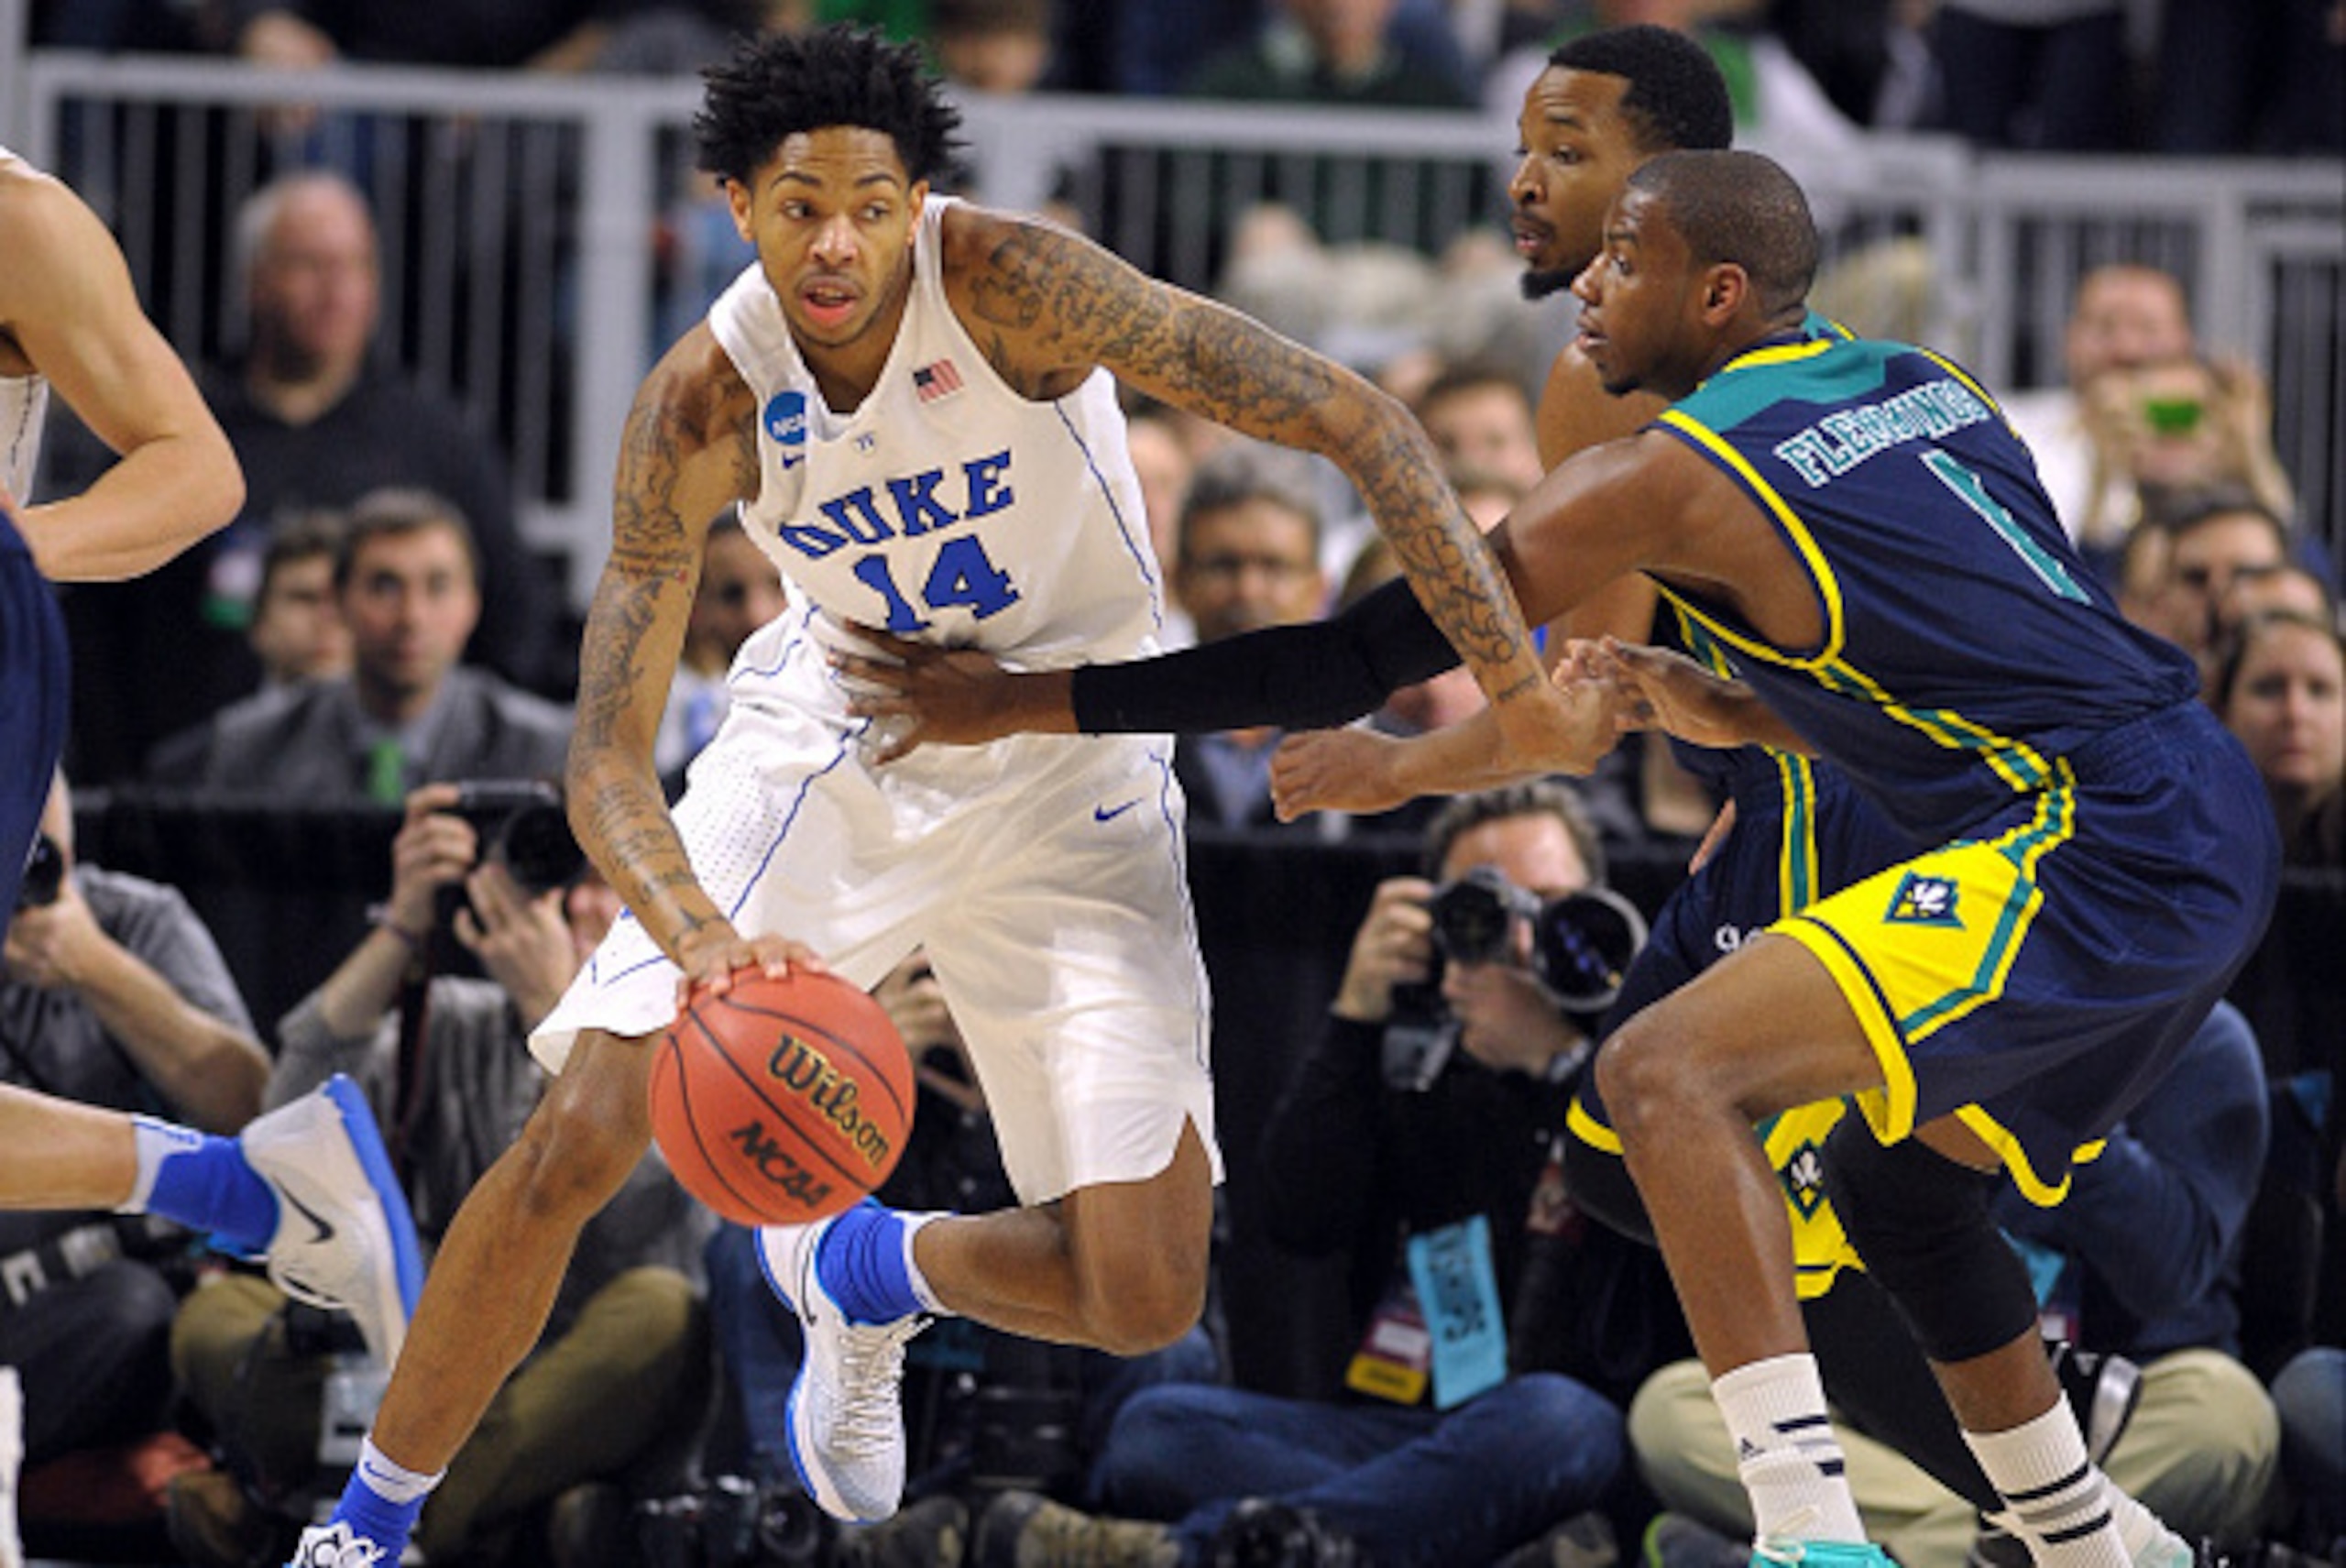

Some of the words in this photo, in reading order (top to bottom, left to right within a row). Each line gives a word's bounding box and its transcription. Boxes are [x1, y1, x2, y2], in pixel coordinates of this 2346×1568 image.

[779, 448, 1014, 558] DUKE
[852, 533, 1021, 633] 14
[767, 1034, 890, 1168] Wilson
[730, 1120, 831, 1209] NCAA
